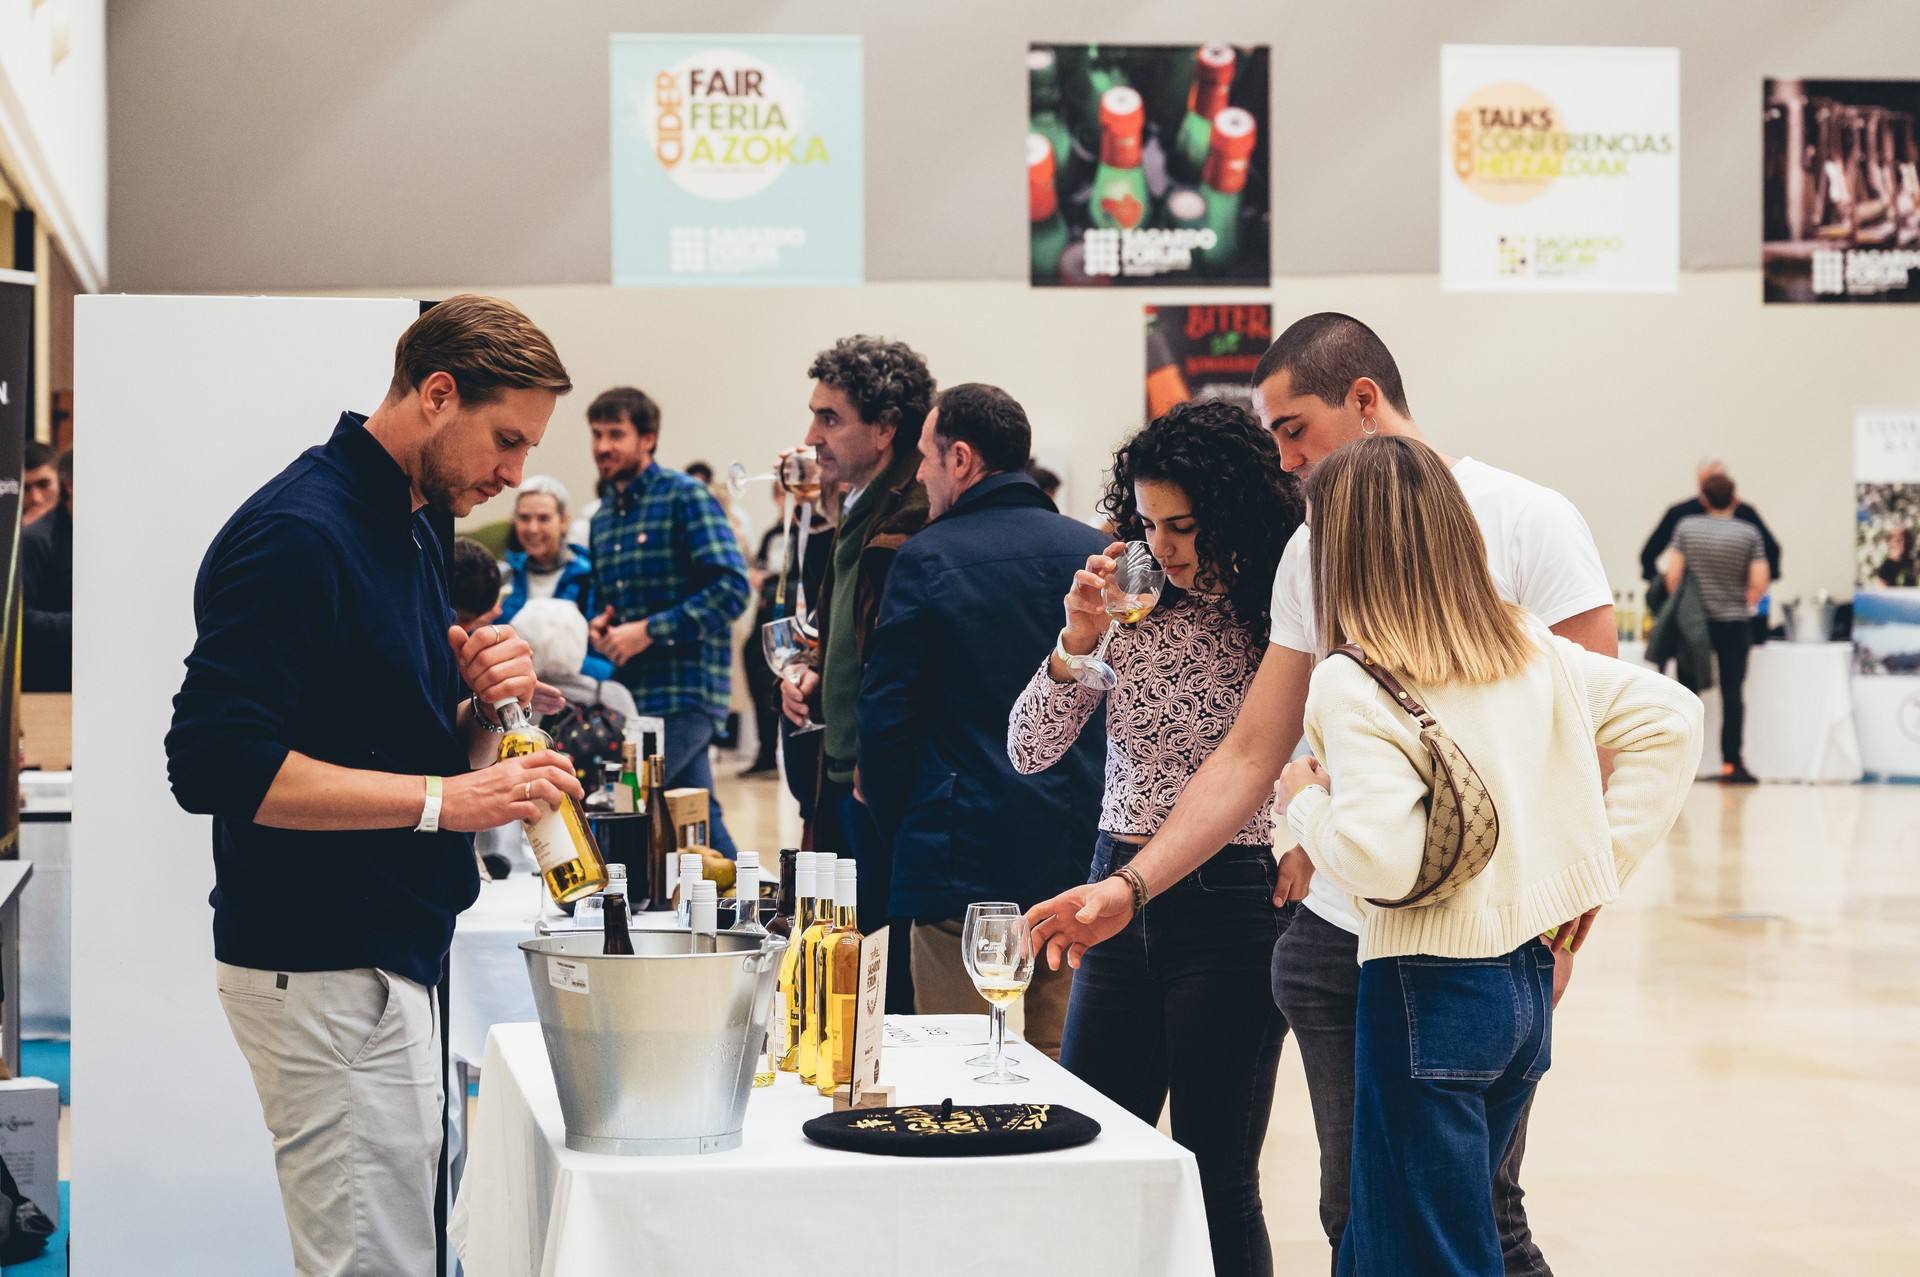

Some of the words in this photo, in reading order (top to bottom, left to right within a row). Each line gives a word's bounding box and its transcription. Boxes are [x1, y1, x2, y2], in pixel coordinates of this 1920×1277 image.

[689, 69, 764, 98] FAIR
[656, 71, 684, 169] CIDER
[689, 102, 788, 130] FERIA
[1478, 107, 1553, 131] TALKS
[689, 135, 831, 165] AZOKA
[1477, 132, 1672, 154] CONFERENCIAS
[1476, 156, 1630, 178] HITZALDIAK
